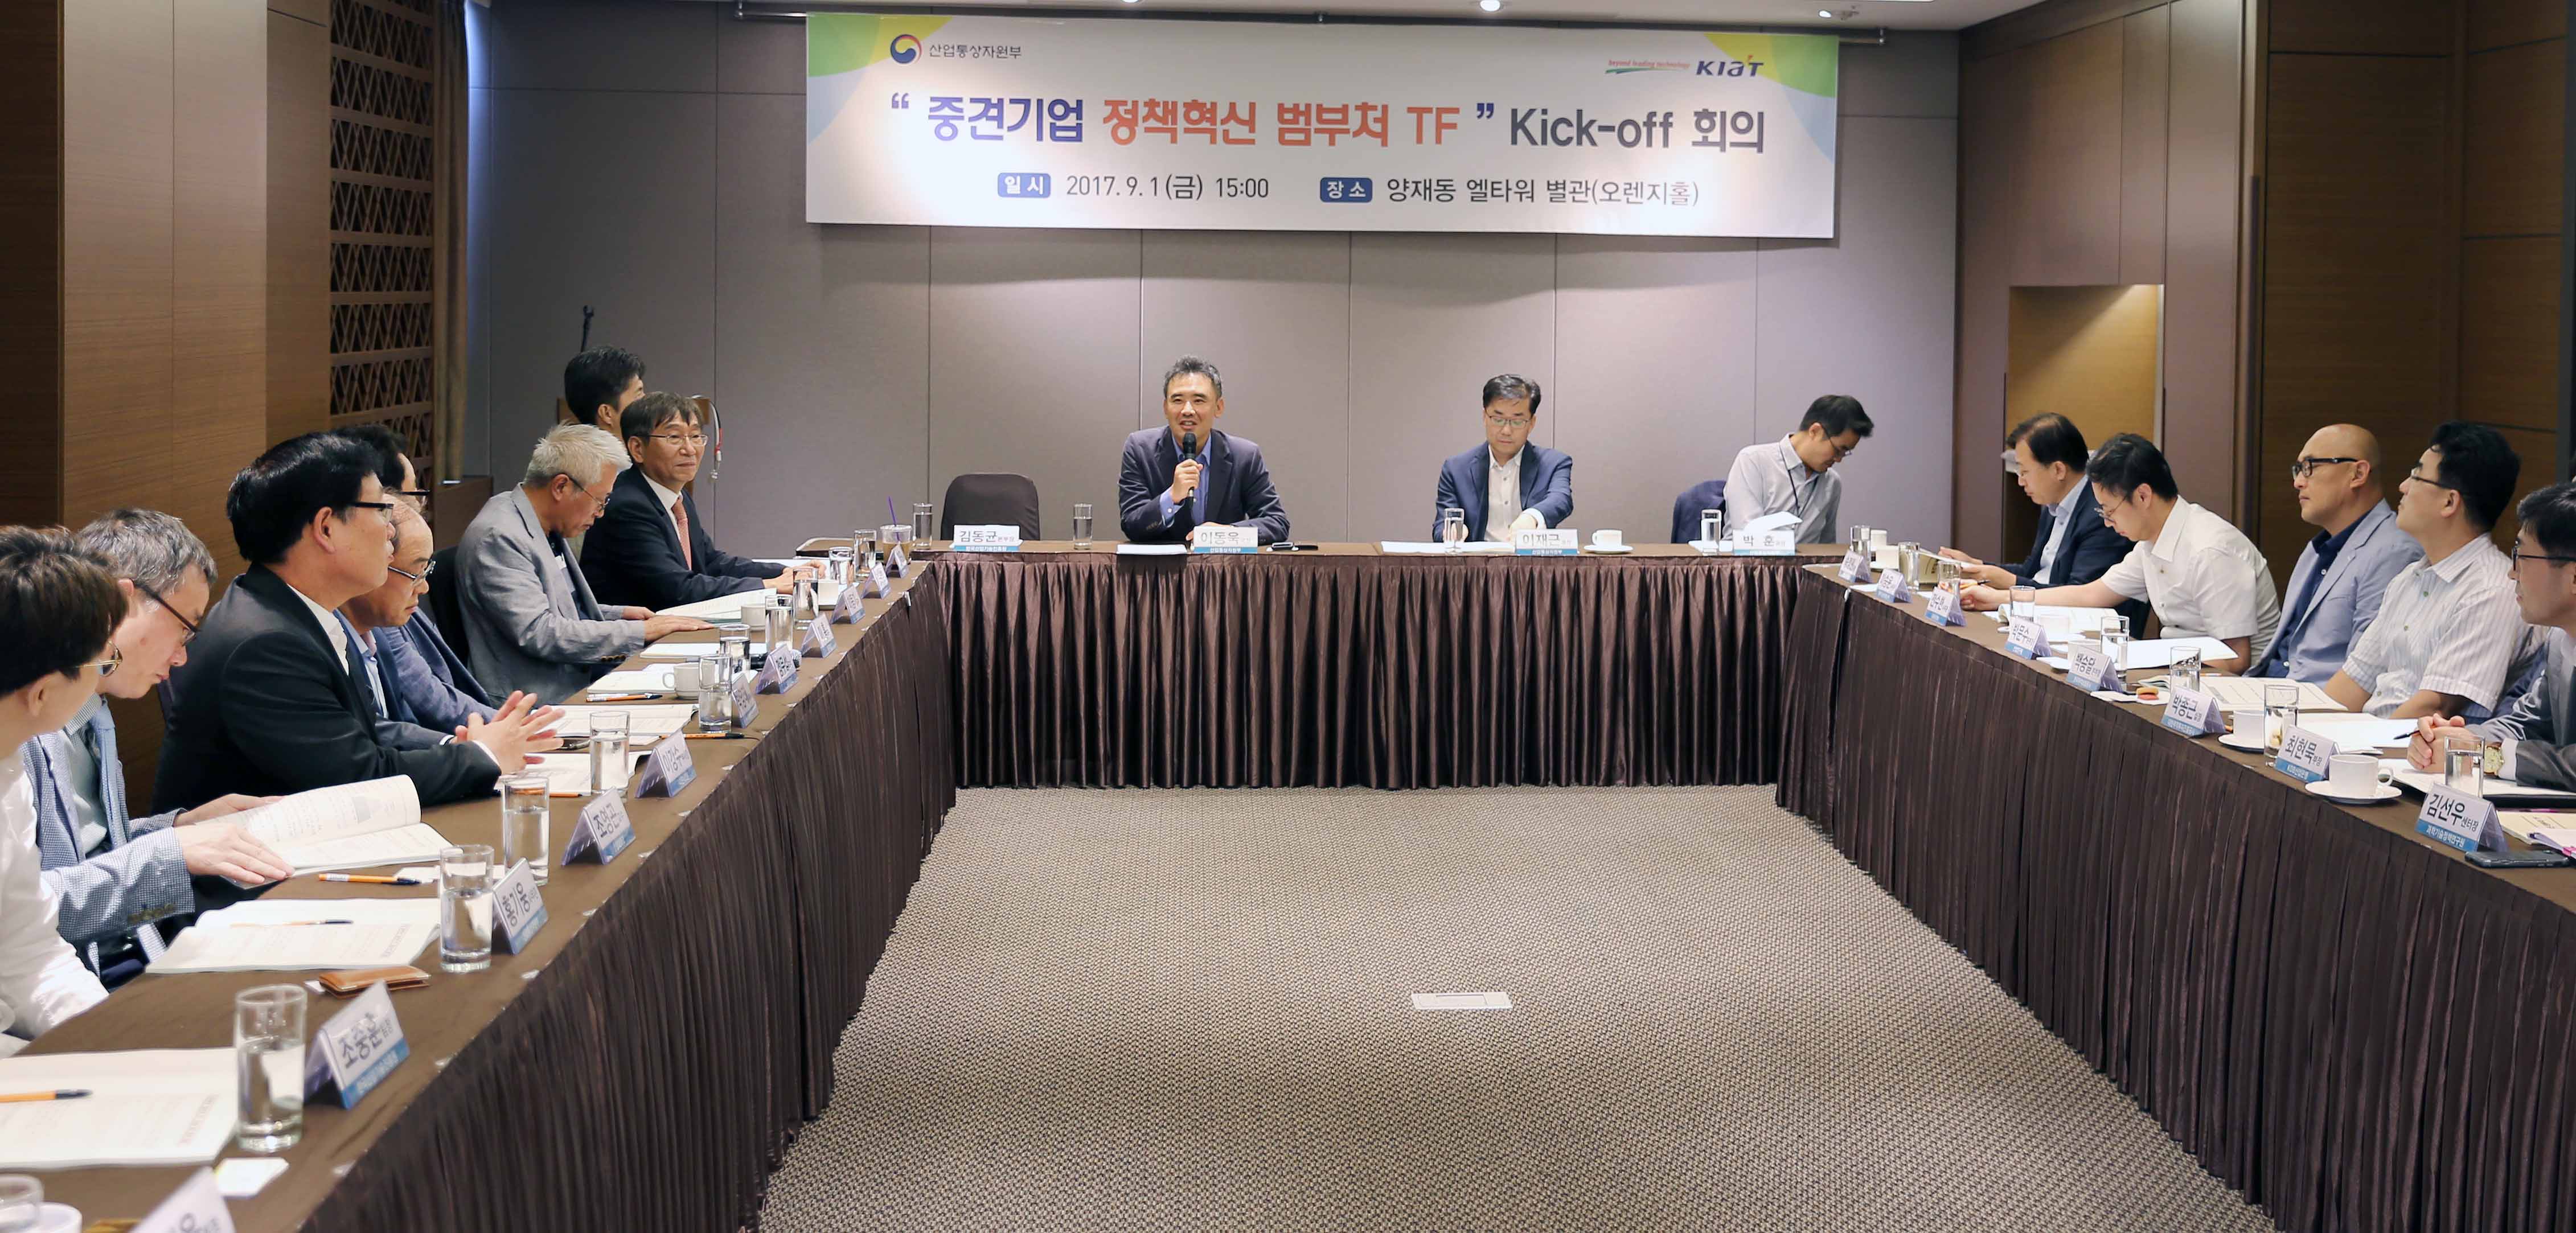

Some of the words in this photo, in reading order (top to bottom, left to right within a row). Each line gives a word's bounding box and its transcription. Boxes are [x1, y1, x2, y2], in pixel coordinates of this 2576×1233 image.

[929, 44, 1022, 59] 산업통상자원부
[928, 96, 1084, 142] 중견기업
[1103, 98, 1256, 146] 정책혁신
[1277, 102, 1389, 147] 범부처
[1406, 107, 1460, 145] TF
[1510, 108, 1674, 148] Kick-off
[1691, 108, 1764, 154] 회의
[1216, 178, 1269, 198] 15:00
[1388, 178, 1456, 202] 양재동
[1466, 179, 1535, 203] 엘타워
[1201, 531, 1240, 545] 이동욱
[2285, 735, 2317, 764] 최현묵
[2427, 794, 2465, 825] 김선우
